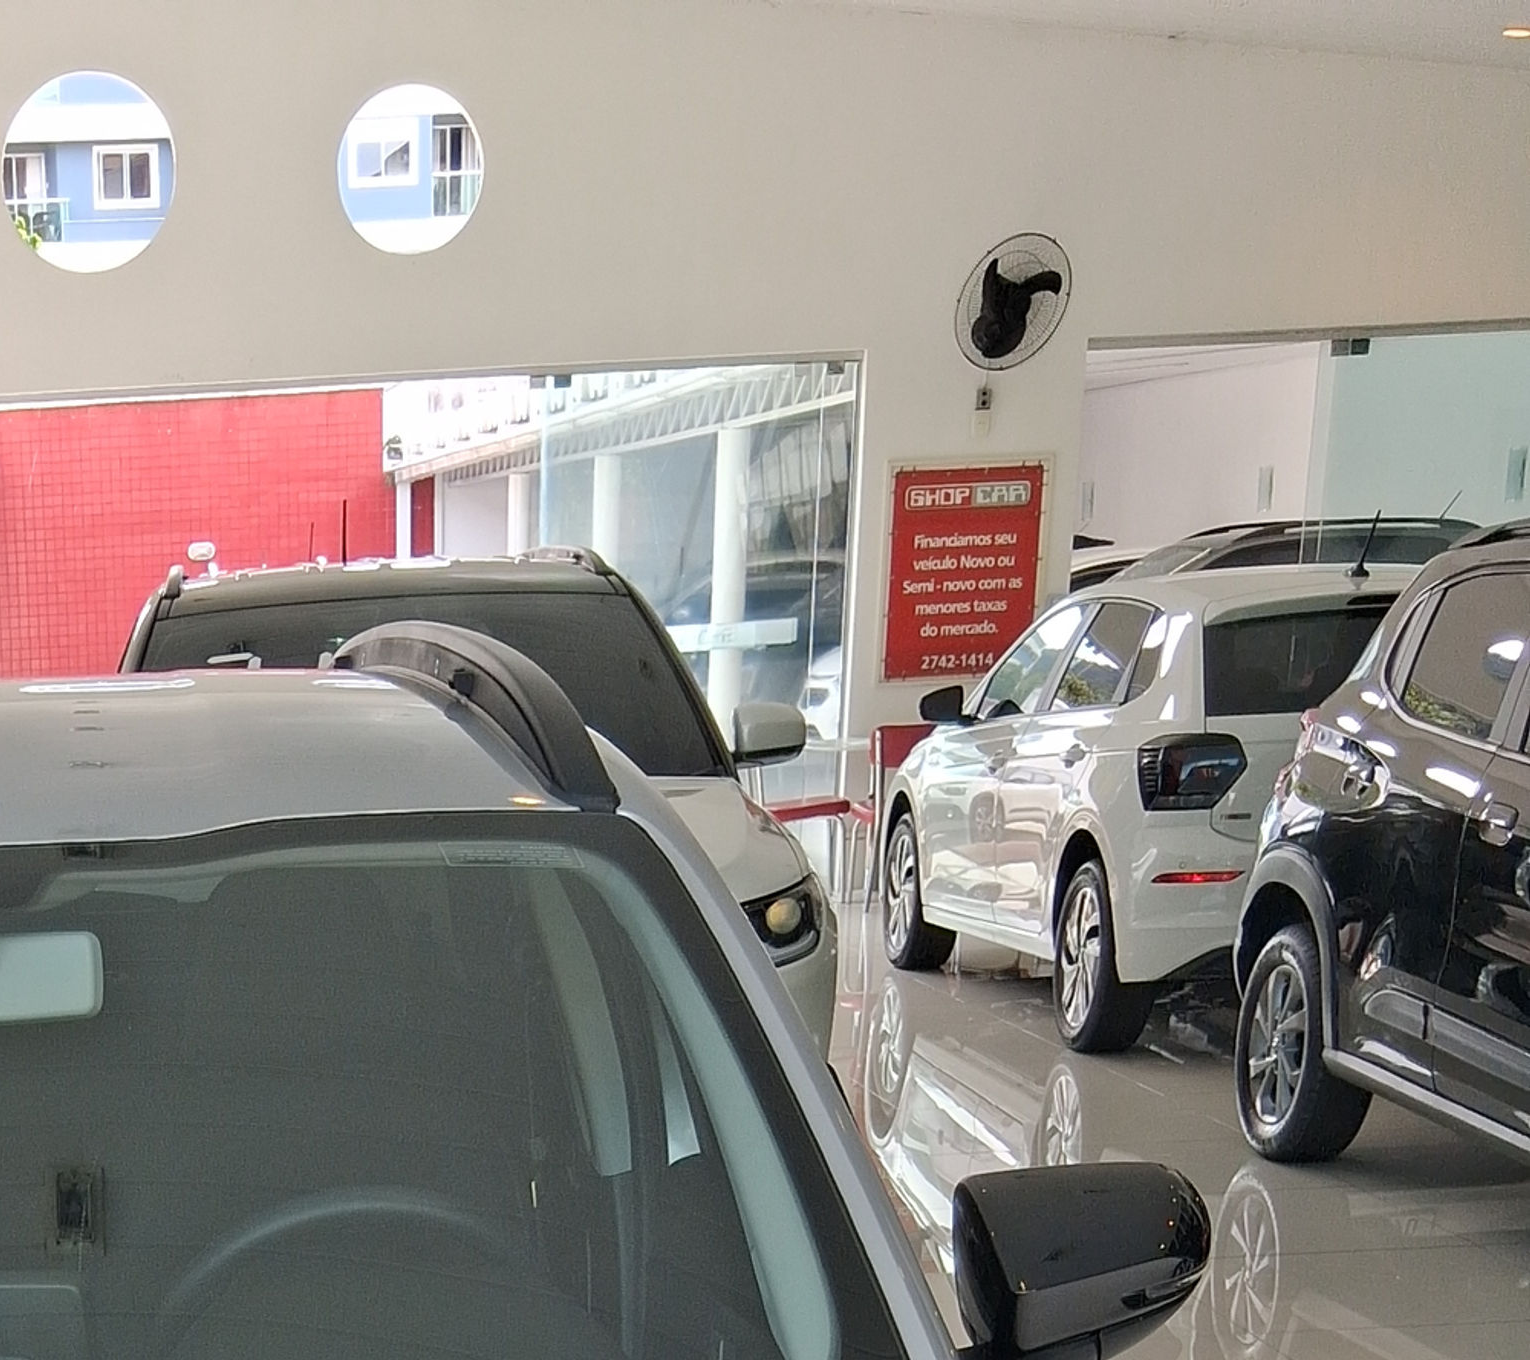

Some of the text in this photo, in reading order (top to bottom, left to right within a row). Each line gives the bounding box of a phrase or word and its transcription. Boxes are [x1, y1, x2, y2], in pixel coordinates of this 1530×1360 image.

[909, 485, 1027, 507] SHOP CAR
[913, 532, 1017, 550] Financiamos seu
[913, 555, 1015, 571] veículo Novo ou
[902, 578, 934, 594] Semi
[943, 578, 975, 592] novo
[978, 578, 1006, 591] com
[1008, 577, 1023, 589] as
[915, 599, 1007, 616] menores taxas
[920, 619, 999, 638] do mercado.
[921, 652, 994, 671] 2742-1414
